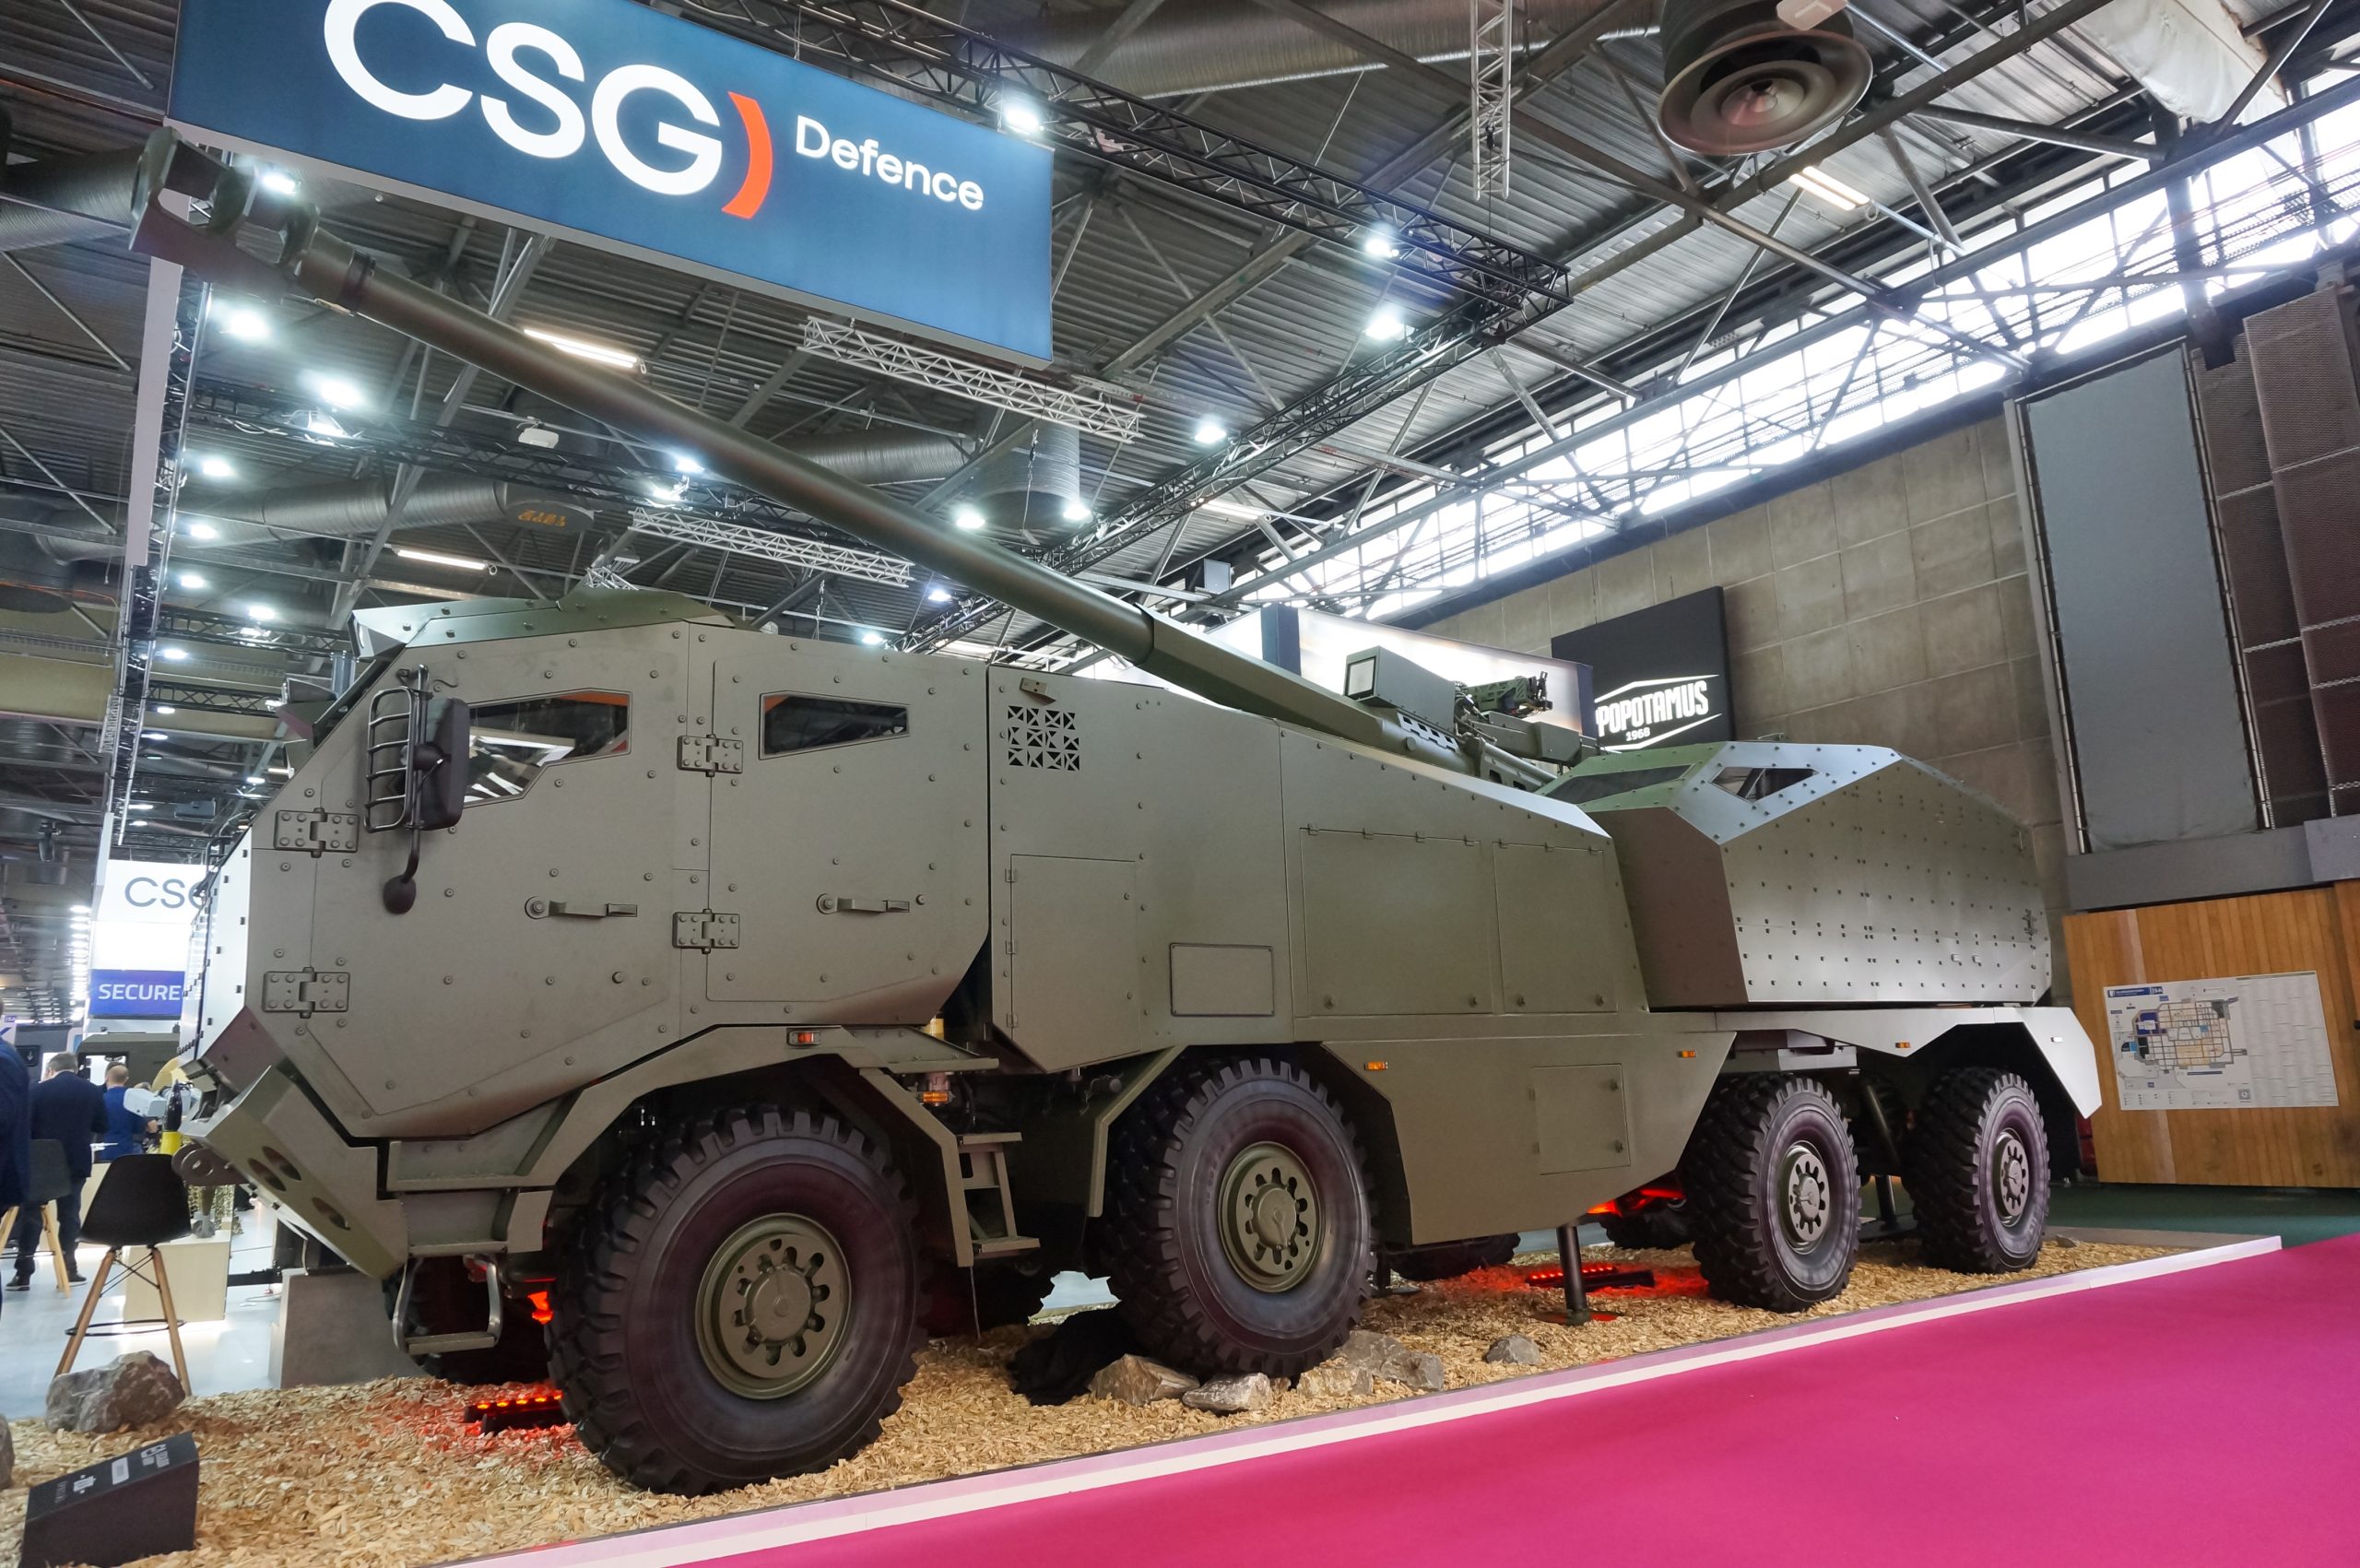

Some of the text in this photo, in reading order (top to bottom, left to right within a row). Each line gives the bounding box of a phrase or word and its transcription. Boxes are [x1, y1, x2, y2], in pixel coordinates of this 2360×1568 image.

[796, 114, 984, 212] Defence
[1595, 679, 1709, 737] POPOTAMUS
[1625, 726, 1650, 741] 1968
[98, 984, 182, 1001] SECURE
